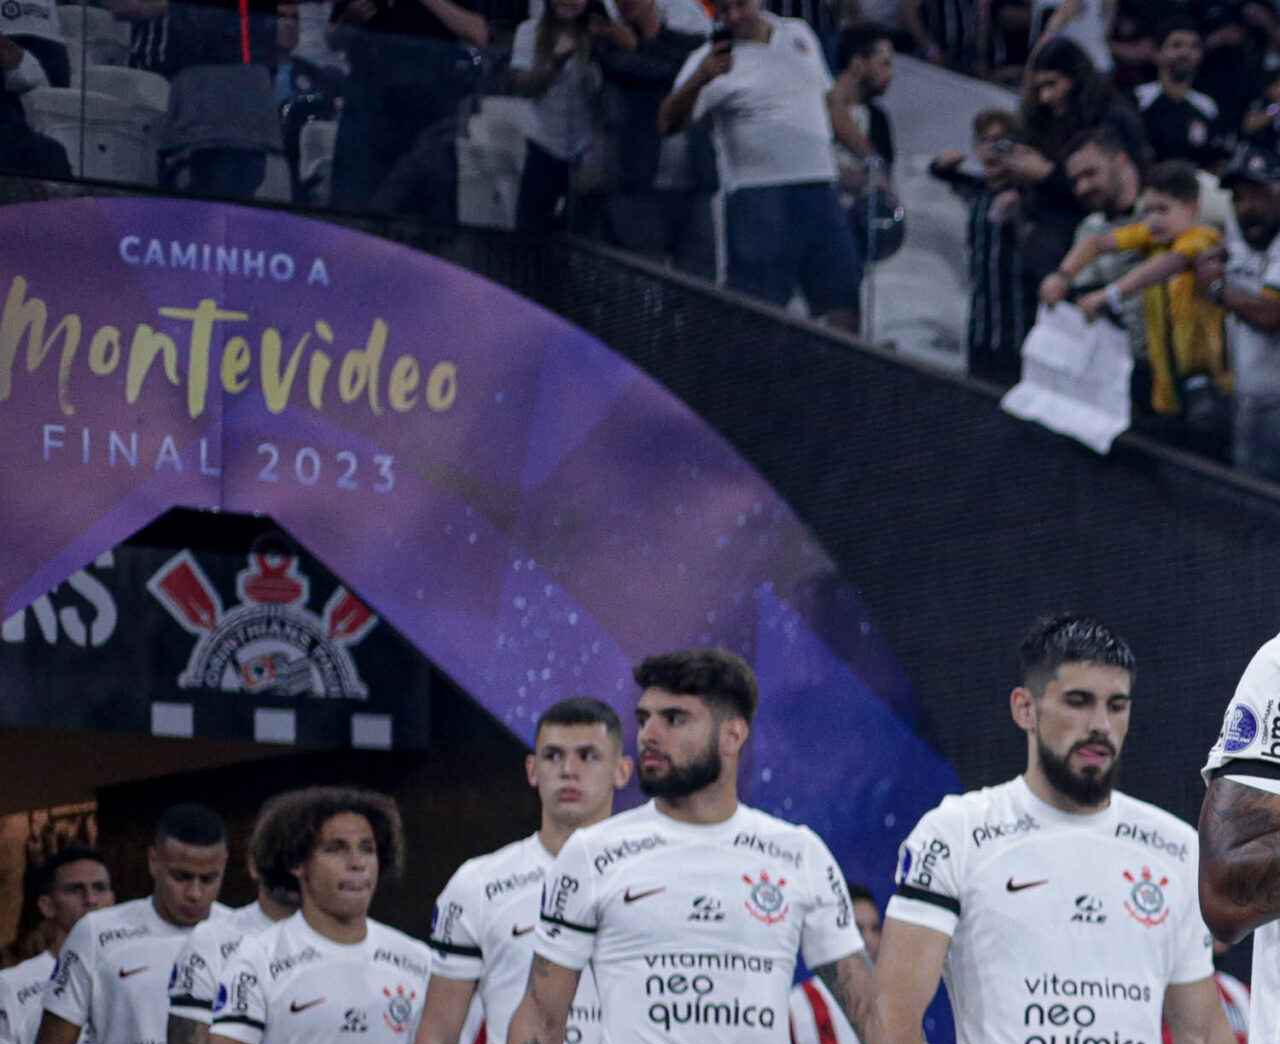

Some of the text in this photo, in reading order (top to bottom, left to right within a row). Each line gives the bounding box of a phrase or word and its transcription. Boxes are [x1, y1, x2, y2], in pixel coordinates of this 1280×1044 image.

[119, 235, 330, 286] CAMINHO A
[0, 275, 457, 420] Montevideo
[42, 424, 396, 493] FINAL 2023
[973, 813, 1040, 848] pixbet
[1115, 822, 1189, 863] pixbet
[594, 832, 667, 875] pixbet
[733, 832, 802, 869] pixbet
[912, 838, 951, 888] bmg
[645, 974, 714, 997] neo
[1024, 973, 1151, 1002] vitaminas
[648, 996, 775, 1032] química
[1024, 1003, 1095, 1027] neo
